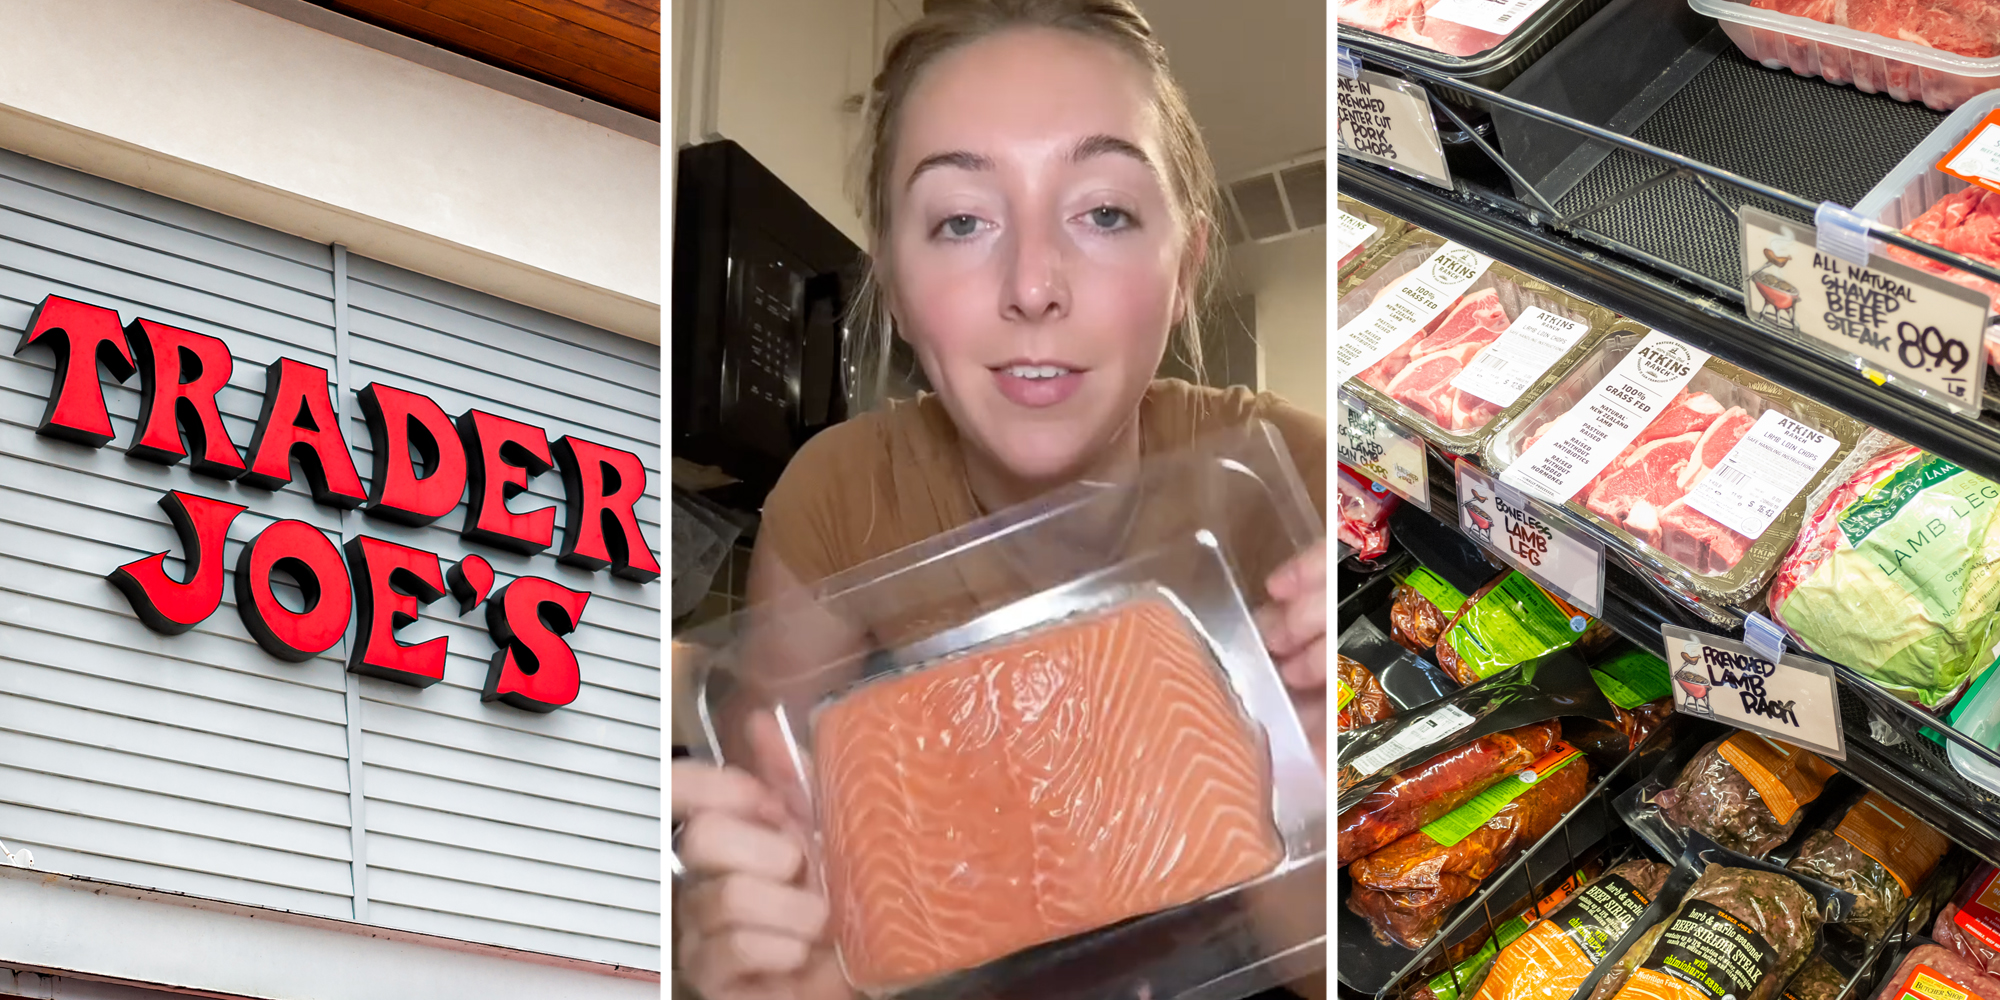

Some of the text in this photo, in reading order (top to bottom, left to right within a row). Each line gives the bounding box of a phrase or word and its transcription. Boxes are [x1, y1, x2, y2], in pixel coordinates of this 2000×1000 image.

[1337, 92, 1385, 114] RENCHED
[1338, 106, 1392, 130] CENTER CUT
[1350, 121, 1388, 144] PORK
[1354, 137, 1398, 160] CHOPS
[1338, 214, 1367, 230] ATKINS
[1434, 254, 1476, 280] ATKINS
[1438, 266, 1460, 280] RANCH
[1812, 252, 1917, 303] ALL NATURAL
[1401, 287, 1438, 310] GRASS FED
[1415, 286, 1435, 300] 100%
[1821, 274, 1900, 313] SHAVED
[1536, 312, 1575, 330] ATKINS
[1826, 291, 1888, 328] BEEF
[1823, 312, 1892, 352] STEAK
[1898, 321, 1970, 374] 8.99
[1638, 346, 1690, 377] ATKINS
[1644, 361, 1670, 377] RANCH
[1606, 385, 1651, 412] GRASS FED
[1622, 384, 1646, 400] 100%
[1590, 406, 1629, 430] NEW ZEALAND
[1596, 416, 1612, 428] LAMB
[14, 293, 661, 584] TRADER
[1580, 428, 1601, 442] RAISED
[1582, 422, 1608, 440] PASTURE
[1778, 418, 1824, 444] ATKINS
[1784, 430, 1808, 444] RANCH
[1350, 438, 1379, 463] LAMB
[1553, 442, 1590, 465] ANTIBIOTICS
[1564, 440, 1590, 458] WITHOUT
[1570, 437, 1592, 452] RAISED
[1746, 436, 1816, 472] SAFE HANDLING INSTRUCTIONS
[1764, 432, 1818, 461] LAMB LOIN CHOPS
[1338, 442, 1357, 462] LOIN
[1360, 456, 1388, 480] CHOPS
[1542, 464, 1562, 478] ADDED
[1544, 458, 1570, 475] WITHOUT
[1551, 454, 1572, 470] RAISED
[1530, 465, 1564, 486] HORMONES
[1900, 478, 1923, 500] FED
[1924, 464, 1958, 480] LAM
[1495, 496, 1552, 540] BONELESS
[1505, 515, 1548, 553] LAMB
[1878, 518, 1946, 576] LAMB
[1951, 486, 1999, 519] LEG
[1509, 536, 1542, 566] LEG
[1945, 559, 1970, 582] GRASS
[106, 489, 592, 714] JOE'S
[1508, 576, 1538, 607] Nutrition Facts
[1942, 609, 1956, 618] NO
[1702, 646, 1776, 678] FRENCHED
[1707, 664, 1767, 698] LAMB
[1738, 690, 1800, 728] RACK
[1586, 886, 1612, 904] BEEF
[1604, 899, 1636, 926] SIRLOI
[1605, 882, 1644, 916] herb & garlic
[1718, 910, 1738, 925] TRADER
[1542, 922, 1564, 942] Nutrition
[1561, 940, 1578, 957] Facts
[1594, 930, 1608, 943] with
[1688, 908, 1764, 962] herb & garlic seasoned
[1671, 919, 1763, 984] BEEF SIRLOIN STEAK
[1664, 954, 1726, 996] chimichurri sauce
[1693, 958, 1708, 972] with
[1638, 970, 1665, 985] Nutrition
[1914, 982, 1964, 1000] BUTCHER SHOP
